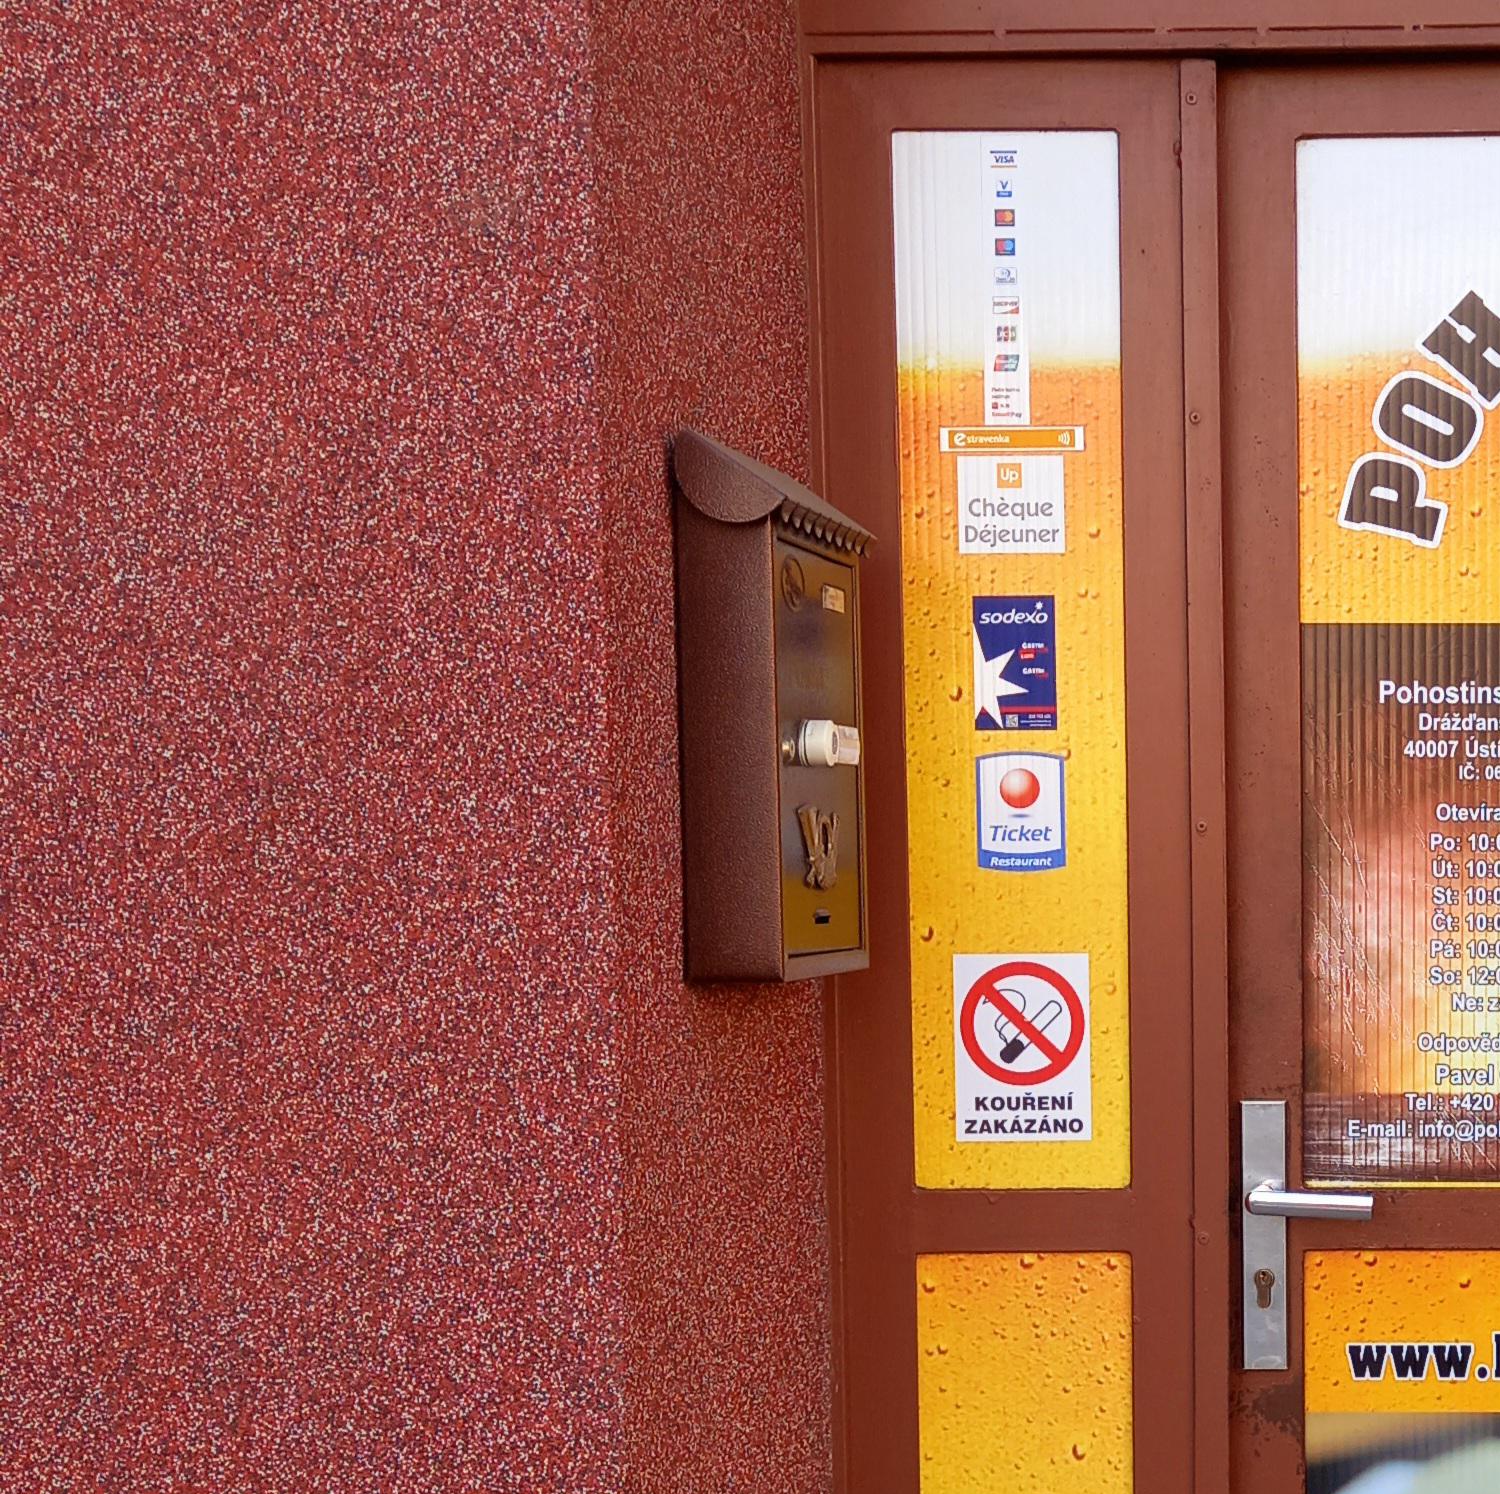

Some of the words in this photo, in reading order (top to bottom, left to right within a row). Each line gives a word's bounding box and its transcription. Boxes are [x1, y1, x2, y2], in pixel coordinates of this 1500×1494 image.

[994, 155, 1015, 163] VISA
[1001, 468, 1018, 483] Up
[968, 497, 1053, 520] Chèque
[964, 525, 1060, 547] Déjeuner
[979, 607, 1048, 624] sodexo
[1403, 740, 1459, 758] 40007
[1458, 764, 1480, 780] IČ:
[989, 825, 1052, 842] Ticket
[1430, 833, 1461, 851] Po:
[990, 857, 1052, 867] Restaurant
[1432, 858, 1459, 878] Út:
[1432, 887, 1459, 905] St:
[1432, 911, 1459, 931] Čt:
[1430, 940, 1461, 958] Pá:
[1430, 967, 1461, 985] So:
[1452, 994, 1483, 1011] Ne:
[1435, 1065, 1494, 1085] Pavel
[974, 1092, 1073, 1111] KOUŘENÍ
[1406, 1094, 1443, 1111] Tel.:
[1449, 1094, 1493, 1111] +420
[965, 1116, 1083, 1133] ZAKÁZÁNO
[1348, 1120, 1412, 1137] E-mail:
